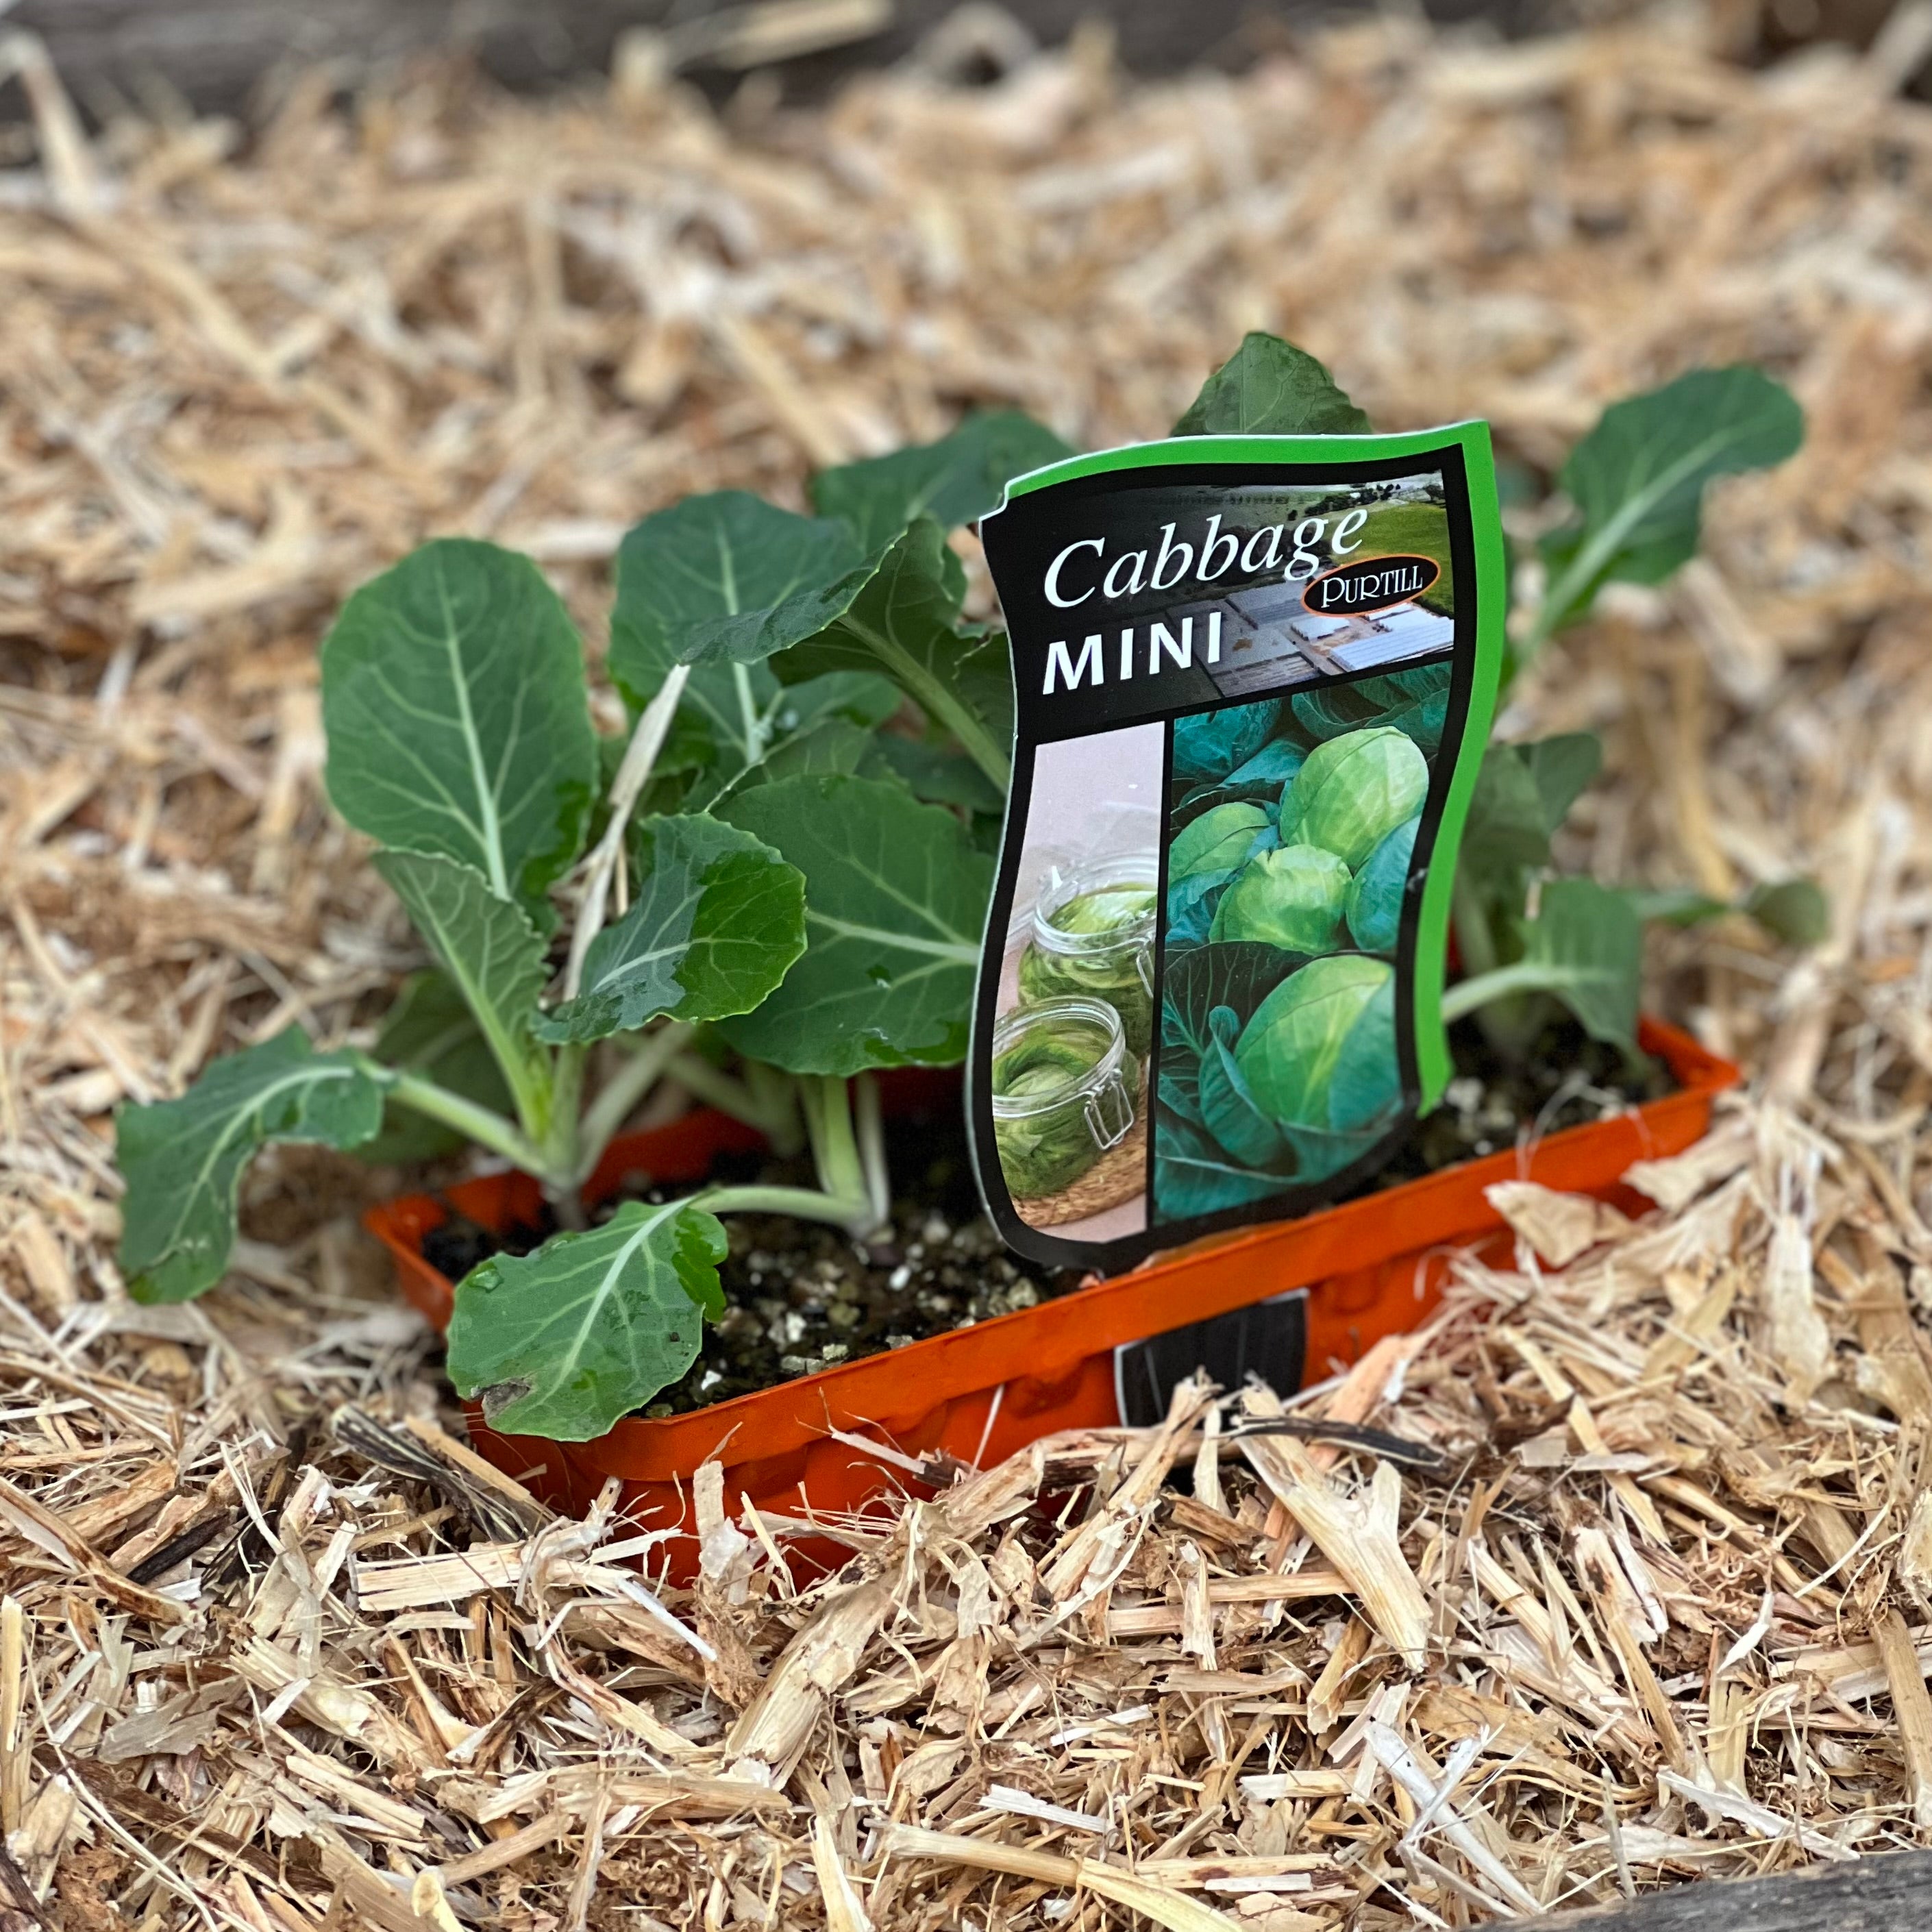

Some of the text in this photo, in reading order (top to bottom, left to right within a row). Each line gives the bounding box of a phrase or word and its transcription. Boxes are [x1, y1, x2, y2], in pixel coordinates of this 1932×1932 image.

[1043, 509, 1368, 608] Cabbage
[1321, 565, 1423, 608] PURTILL
[1042, 611, 1222, 695] MINI
